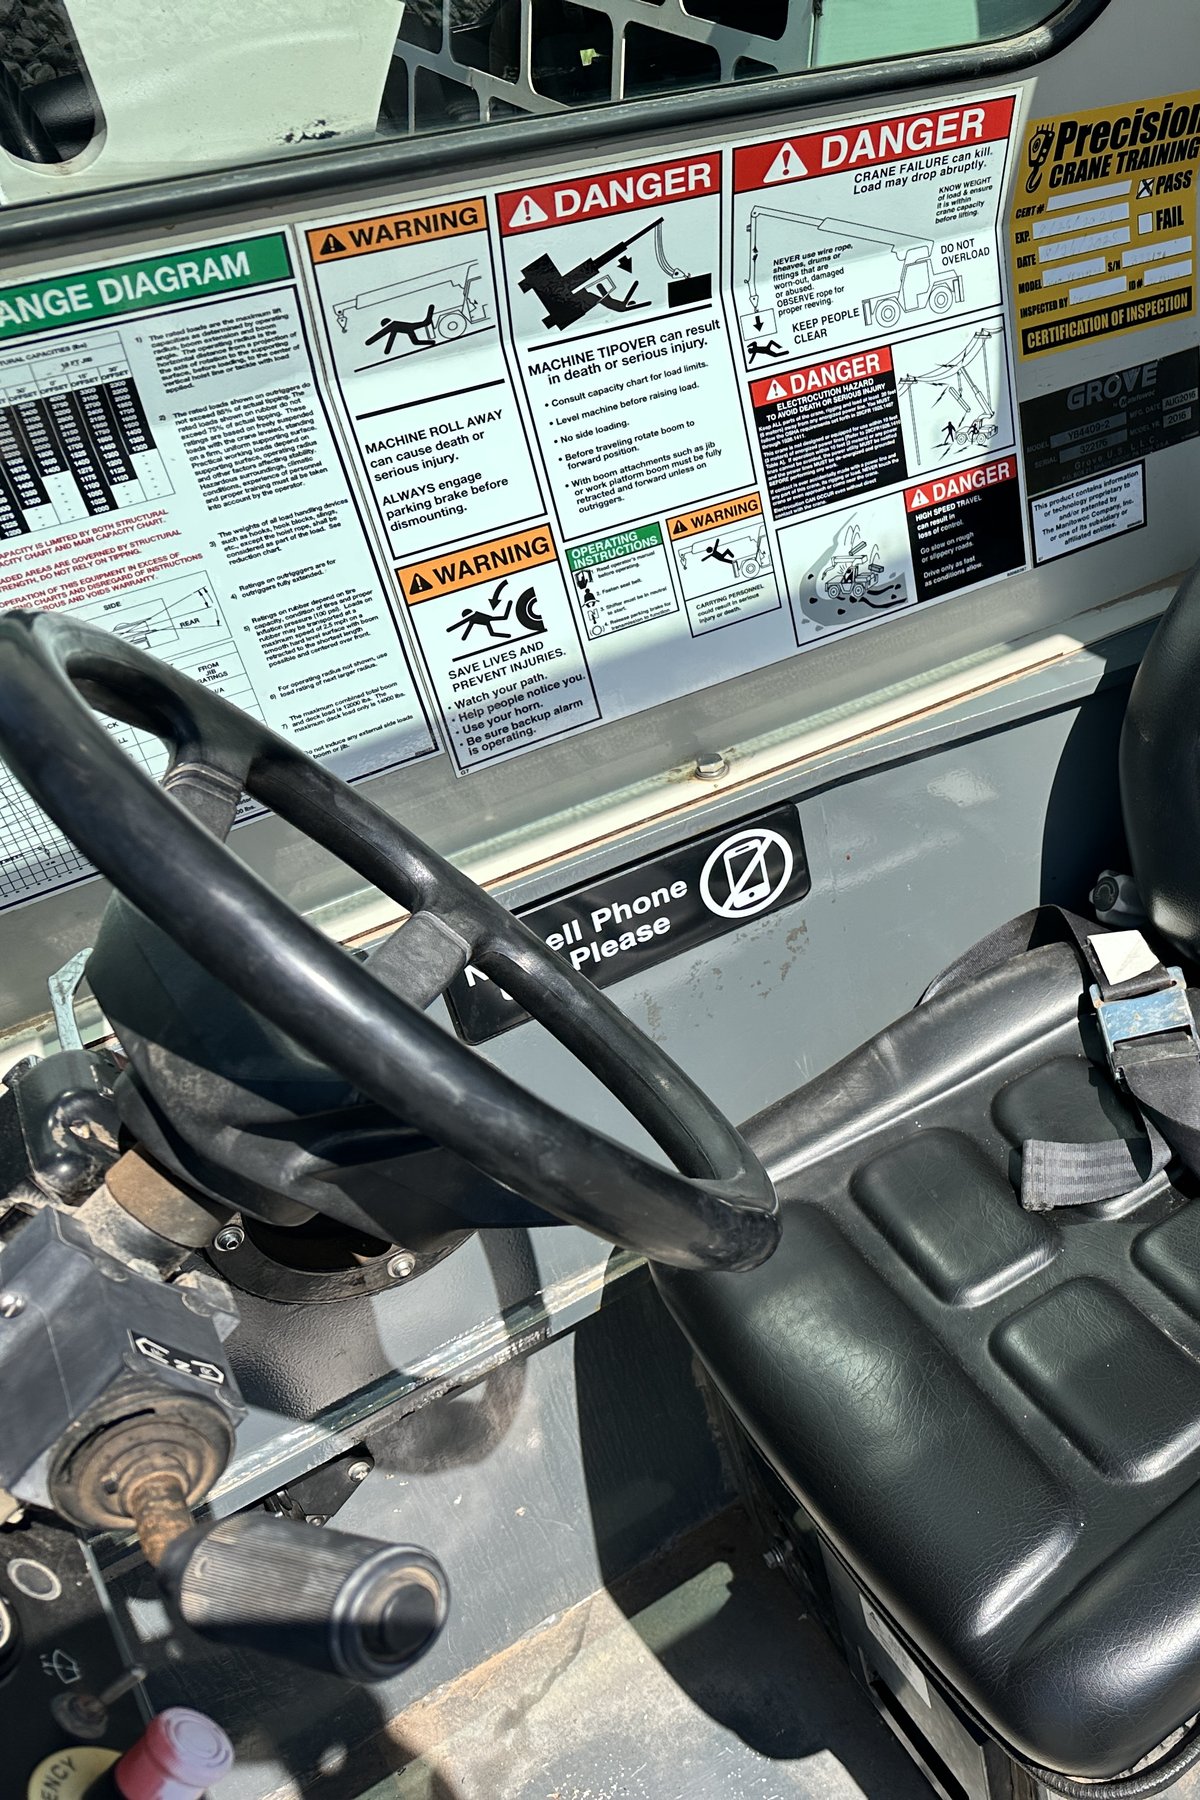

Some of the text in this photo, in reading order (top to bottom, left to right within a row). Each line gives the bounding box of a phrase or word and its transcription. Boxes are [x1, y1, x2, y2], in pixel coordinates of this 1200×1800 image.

[821, 107, 985, 170] DANGER
[853, 159, 986, 195] Load may drop abruptly.
[854, 146, 992, 184] CRANE FAILURE can kill.
[1049, 136, 1200, 188] CRANE TRAINING
[554, 163, 711, 218] DANGER
[938, 176, 992, 194] KNOW WEIGHT
[1155, 170, 1193, 195] PASS
[348, 207, 478, 247] WARNING
[1156, 205, 1184, 231] FAIL
[773, 243, 853, 266] NEVER use wire rope,
[940, 237, 974, 254] DO NOT
[941, 246, 990, 266] OVERLOAD
[1015, 232, 1031, 244] EXP.
[1017, 254, 1036, 269] DATE
[1018, 260, 1121, 294] MODEL S/N
[0, 251, 251, 327] ANGE DIAGRAM
[1019, 299, 1058, 319] INSPECTED
[1058, 296, 1068, 309] BY
[1129, 280, 1136, 291] ID
[791, 307, 860, 333] KEEP PEOPLE
[793, 328, 828, 344] CLEAR
[1027, 292, 1188, 348] CERTIFICATION OF INSPECTION
[527, 319, 721, 376] MACHINE TIPOVER can result
[547, 337, 708, 385] in death or serious injury.
[551, 361, 708, 407] Consult capacity chart for load limits.
[790, 353, 880, 395] DANGER
[1067, 361, 1159, 411] GROVE
[766, 382, 886, 421] TO AVOID DEATH OR SERIOUS INJURY
[776, 377, 874, 411] ELECTROCUTION HAZARD
[364, 408, 502, 454] MACHINE ROLL AWAY
[370, 431, 484, 468] can cause death or
[374, 453, 459, 482] serious injury.
[933, 462, 1010, 501] DANGER
[382, 472, 482, 506] ALWAYS engage
[385, 478, 508, 521] parking brake before
[390, 504, 467, 532] dismounting.
[690, 499, 759, 529] WARNING
[915, 495, 981, 522] HIGH SPEED TRAVEL
[1041, 498, 1134, 535] The Manitowoc Company, Inc.
[0, 509, 169, 560] APACITY IS LIMITED BY BOTH STRUCTURAL
[571, 531, 638, 559] OPERATING
[574, 535, 658, 569] INSTRUCTIONS
[433, 536, 549, 585] WARNING
[695, 583, 764, 610] CARRYING PERSONNEL
[448, 641, 544, 680] SAVE LIVES AND
[452, 648, 566, 692] PREVENT INJURIES.
[453, 672, 548, 709] Watch your path.
[458, 673, 586, 722] Help people notice you.
[462, 701, 543, 734] Use your horn.
[466, 699, 583, 746] Be sure backup alarm
[467, 727, 536, 756] is operating.
[545, 880, 688, 951] ell Phone
[569, 916, 671, 971] Please
[40, 1756, 77, 1800] ENCY
